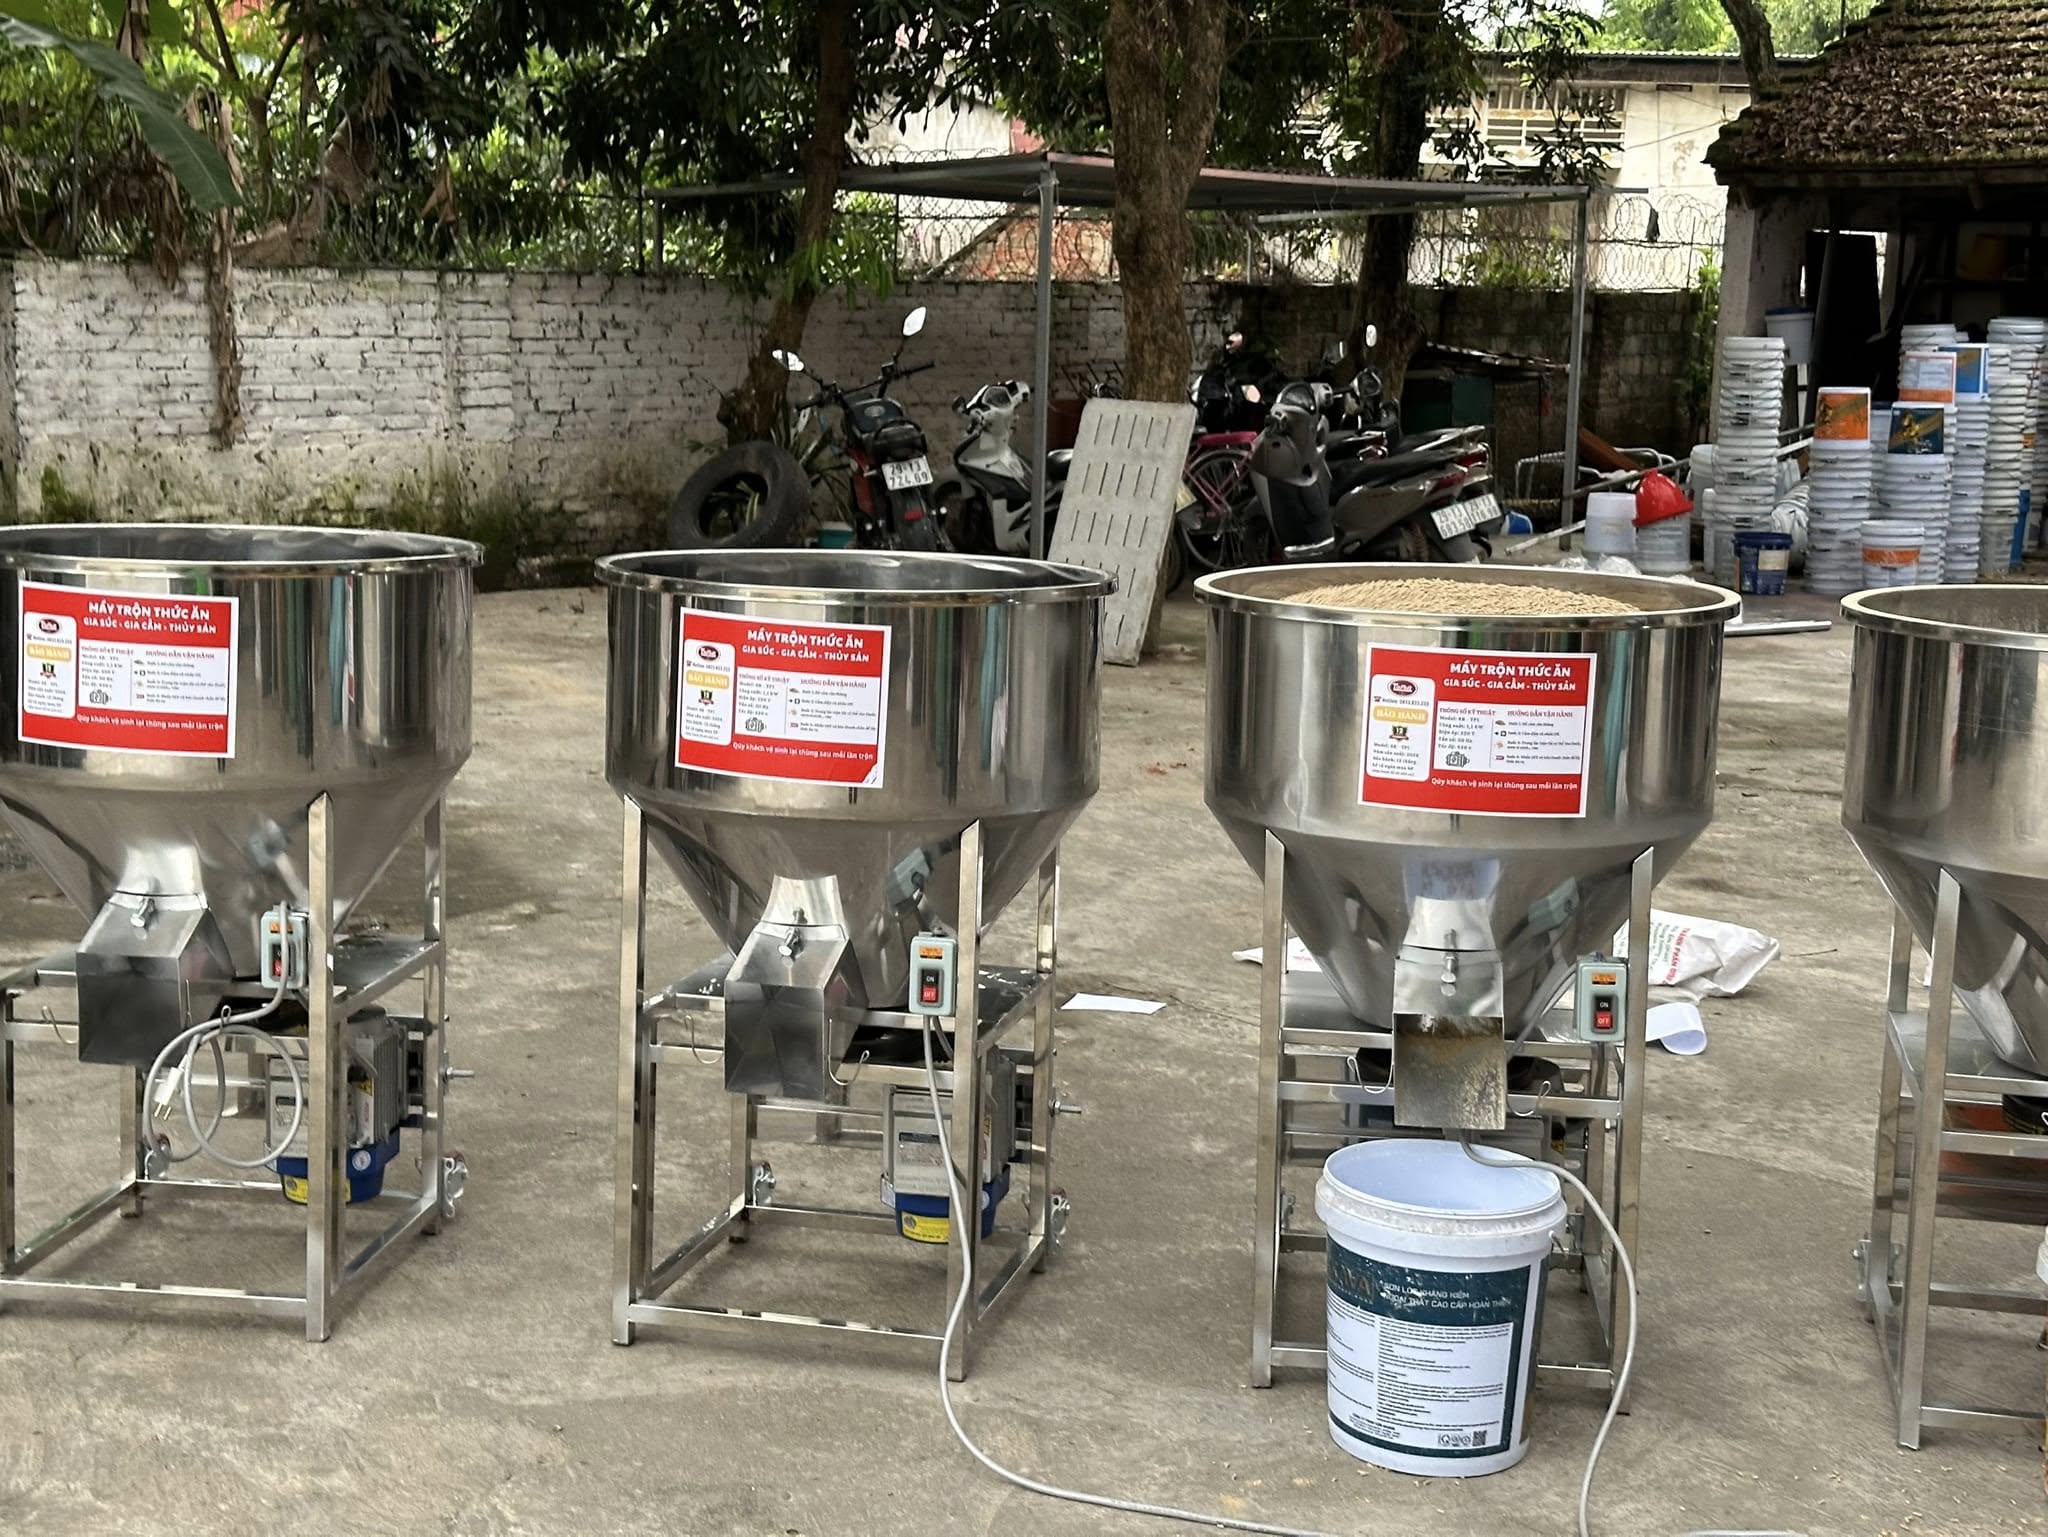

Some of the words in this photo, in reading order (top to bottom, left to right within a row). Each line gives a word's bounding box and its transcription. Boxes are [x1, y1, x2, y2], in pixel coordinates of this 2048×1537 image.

[89, 600, 114, 614] MÁY
[117, 602, 150, 619] TRỘN
[154, 604, 188, 619] THỨC
[191, 605, 210, 620] ĂN
[84, 617, 98, 626] GIA
[100, 617, 117, 628] SÚC
[124, 621, 139, 630] GIA
[142, 618, 161, 631] CẦM
[169, 621, 194, 632] THỦY
[197, 623, 216, 634] SẢN
[748, 628, 772, 642] MÁY
[775, 630, 807, 646] TRỘN
[810, 633, 843, 647] THỨC
[845, 634, 863, 648] ĂN
[742, 645, 756, 654] GIA
[758, 644, 774, 655] SÚC
[781, 648, 796, 657] GIA
[798, 646, 816, 658] CẦM
[824, 650, 849, 661] THỦY
[850, 651, 869, 662] SẢN
[1450, 661, 1478, 674] MÁY
[1480, 662, 1515, 679] TRỘN
[1518, 663, 1552, 677] THỨC
[1554, 664, 1570, 677] ĂN
[1444, 679, 1459, 687] GIA
[1462, 678, 1480, 688] SÚC
[1487, 681, 1502, 689] GIA
[1505, 678, 1524, 690] CẦM
[1532, 680, 1556, 690] THỦY
[1558, 680, 1576, 690] SẢN
[924, 991, 936, 999] OFF
[1598, 1017, 1610, 1025] OFF
[1431, 1300, 1448, 1309] CAO
